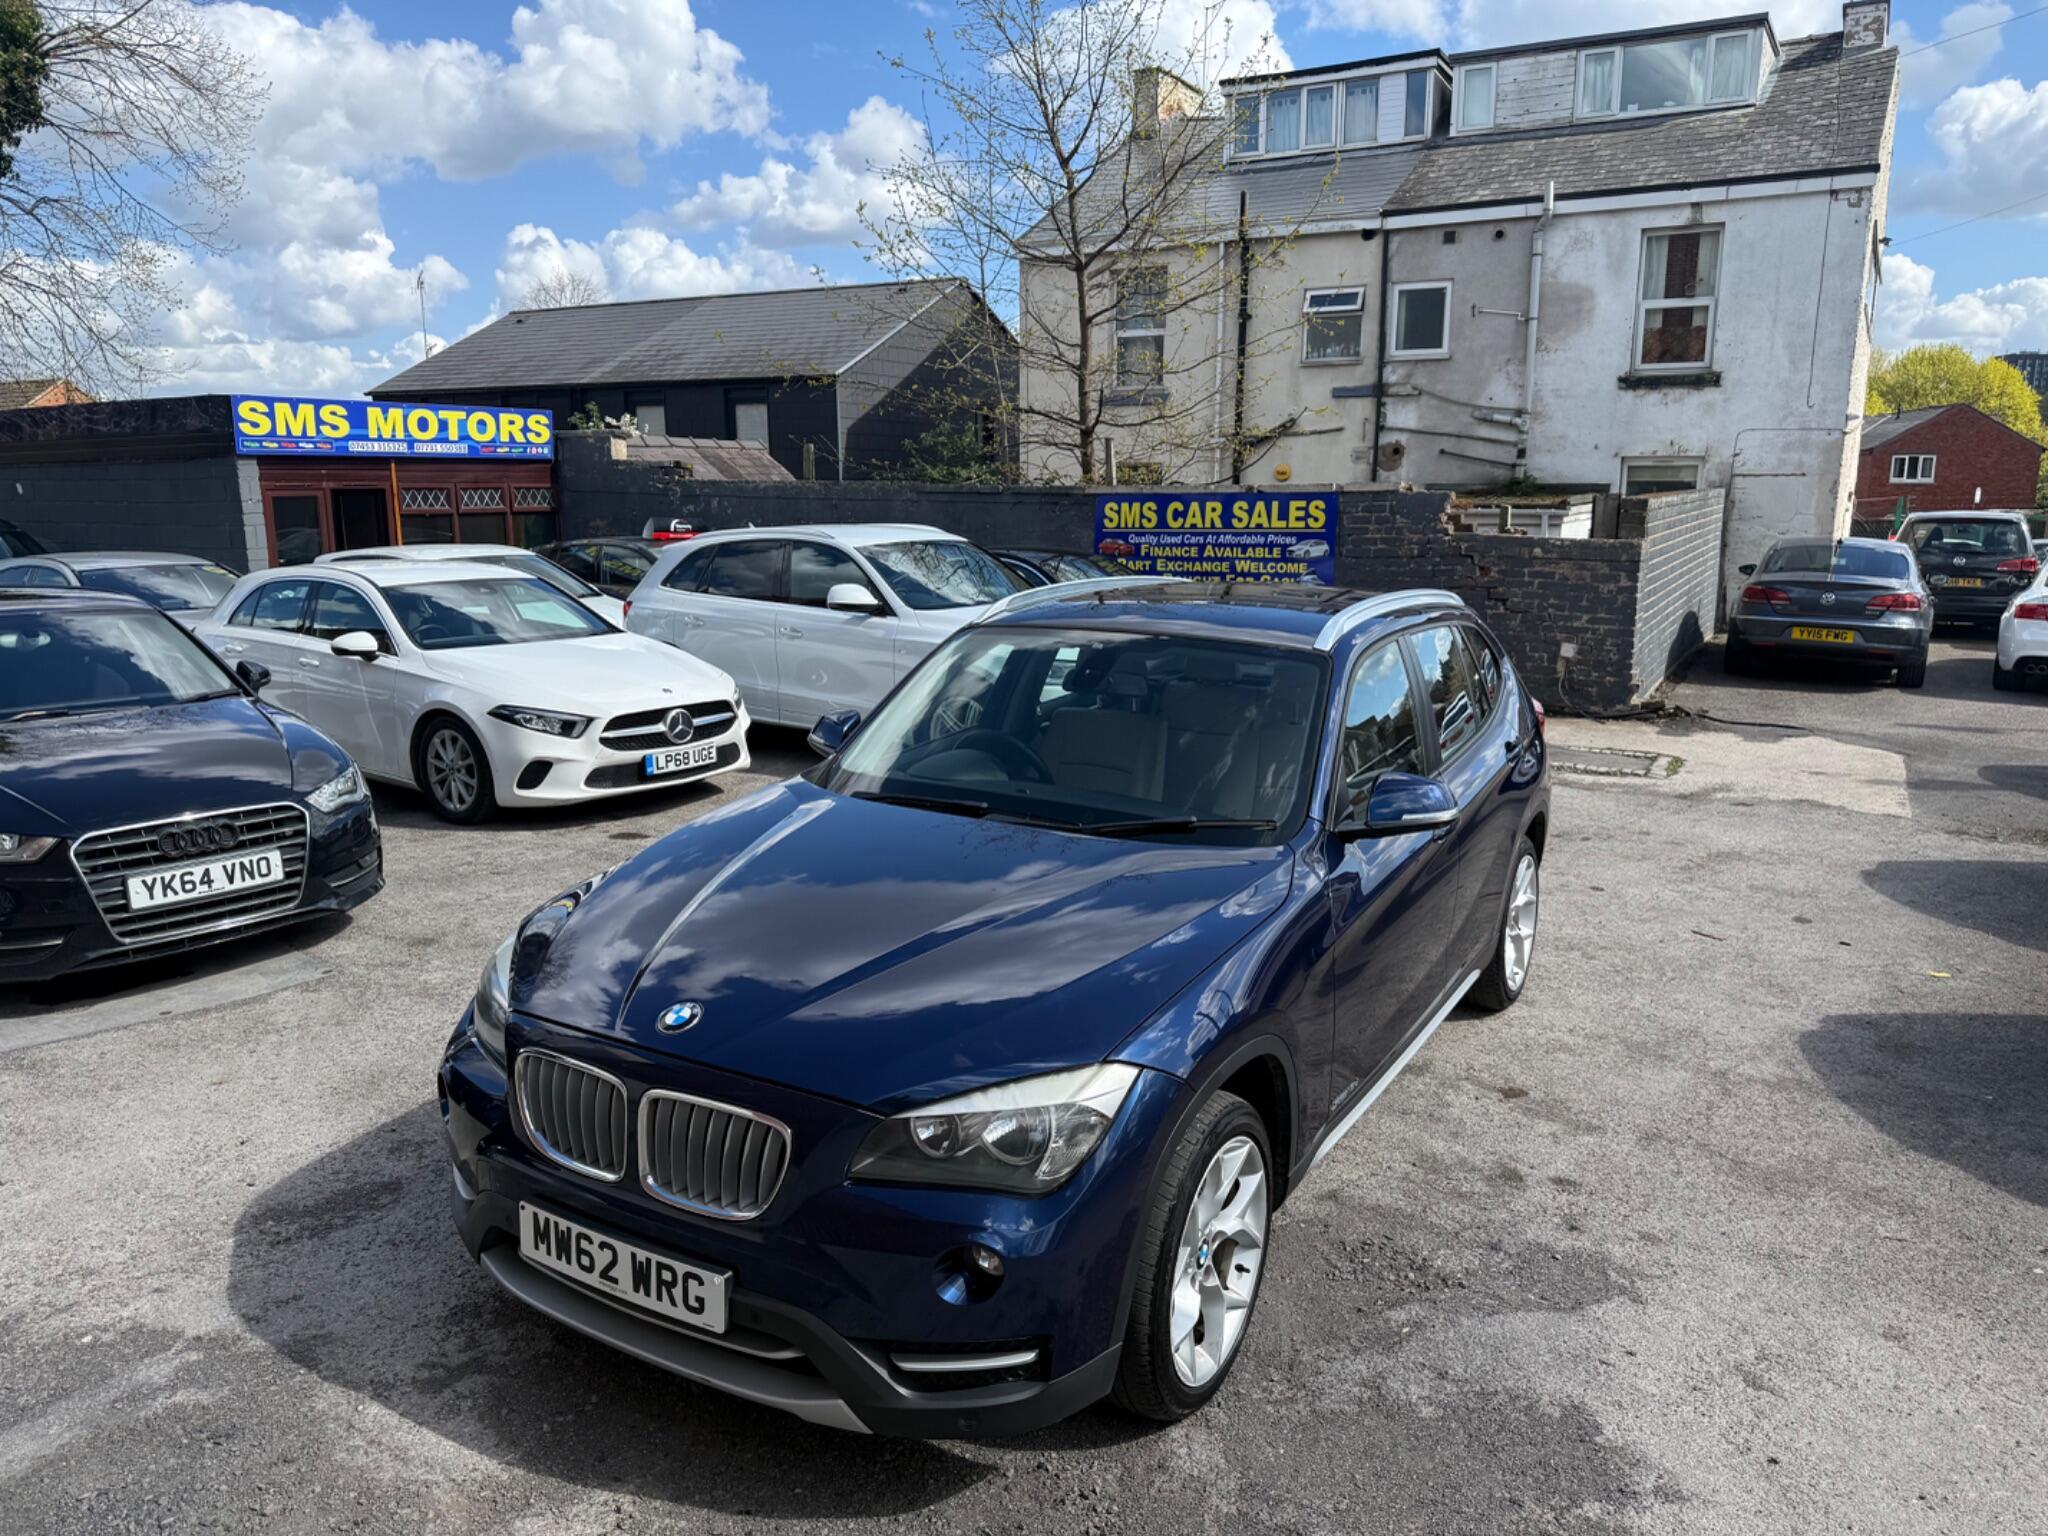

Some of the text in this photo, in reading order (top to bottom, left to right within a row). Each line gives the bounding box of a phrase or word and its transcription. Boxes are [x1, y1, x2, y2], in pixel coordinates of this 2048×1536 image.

[237, 400, 551, 444] SMS MOTORS
[1103, 500, 1327, 529] SMS CAR SALES
[1128, 534, 1297, 546] Quality Used Cars At Affordable Prices
[1140, 544, 1281, 559] FINANCE AVAILABLE
[1156, 558, 1230, 573] EXCHANGE
[1235, 559, 1308, 574] WELCOME
[1799, 628, 1848, 640] YY15 FWG
[656, 745, 714, 771] LP68 UGE
[141, 856, 272, 900] YK64 VNO
[532, 1211, 705, 1316] MW62 WRG
